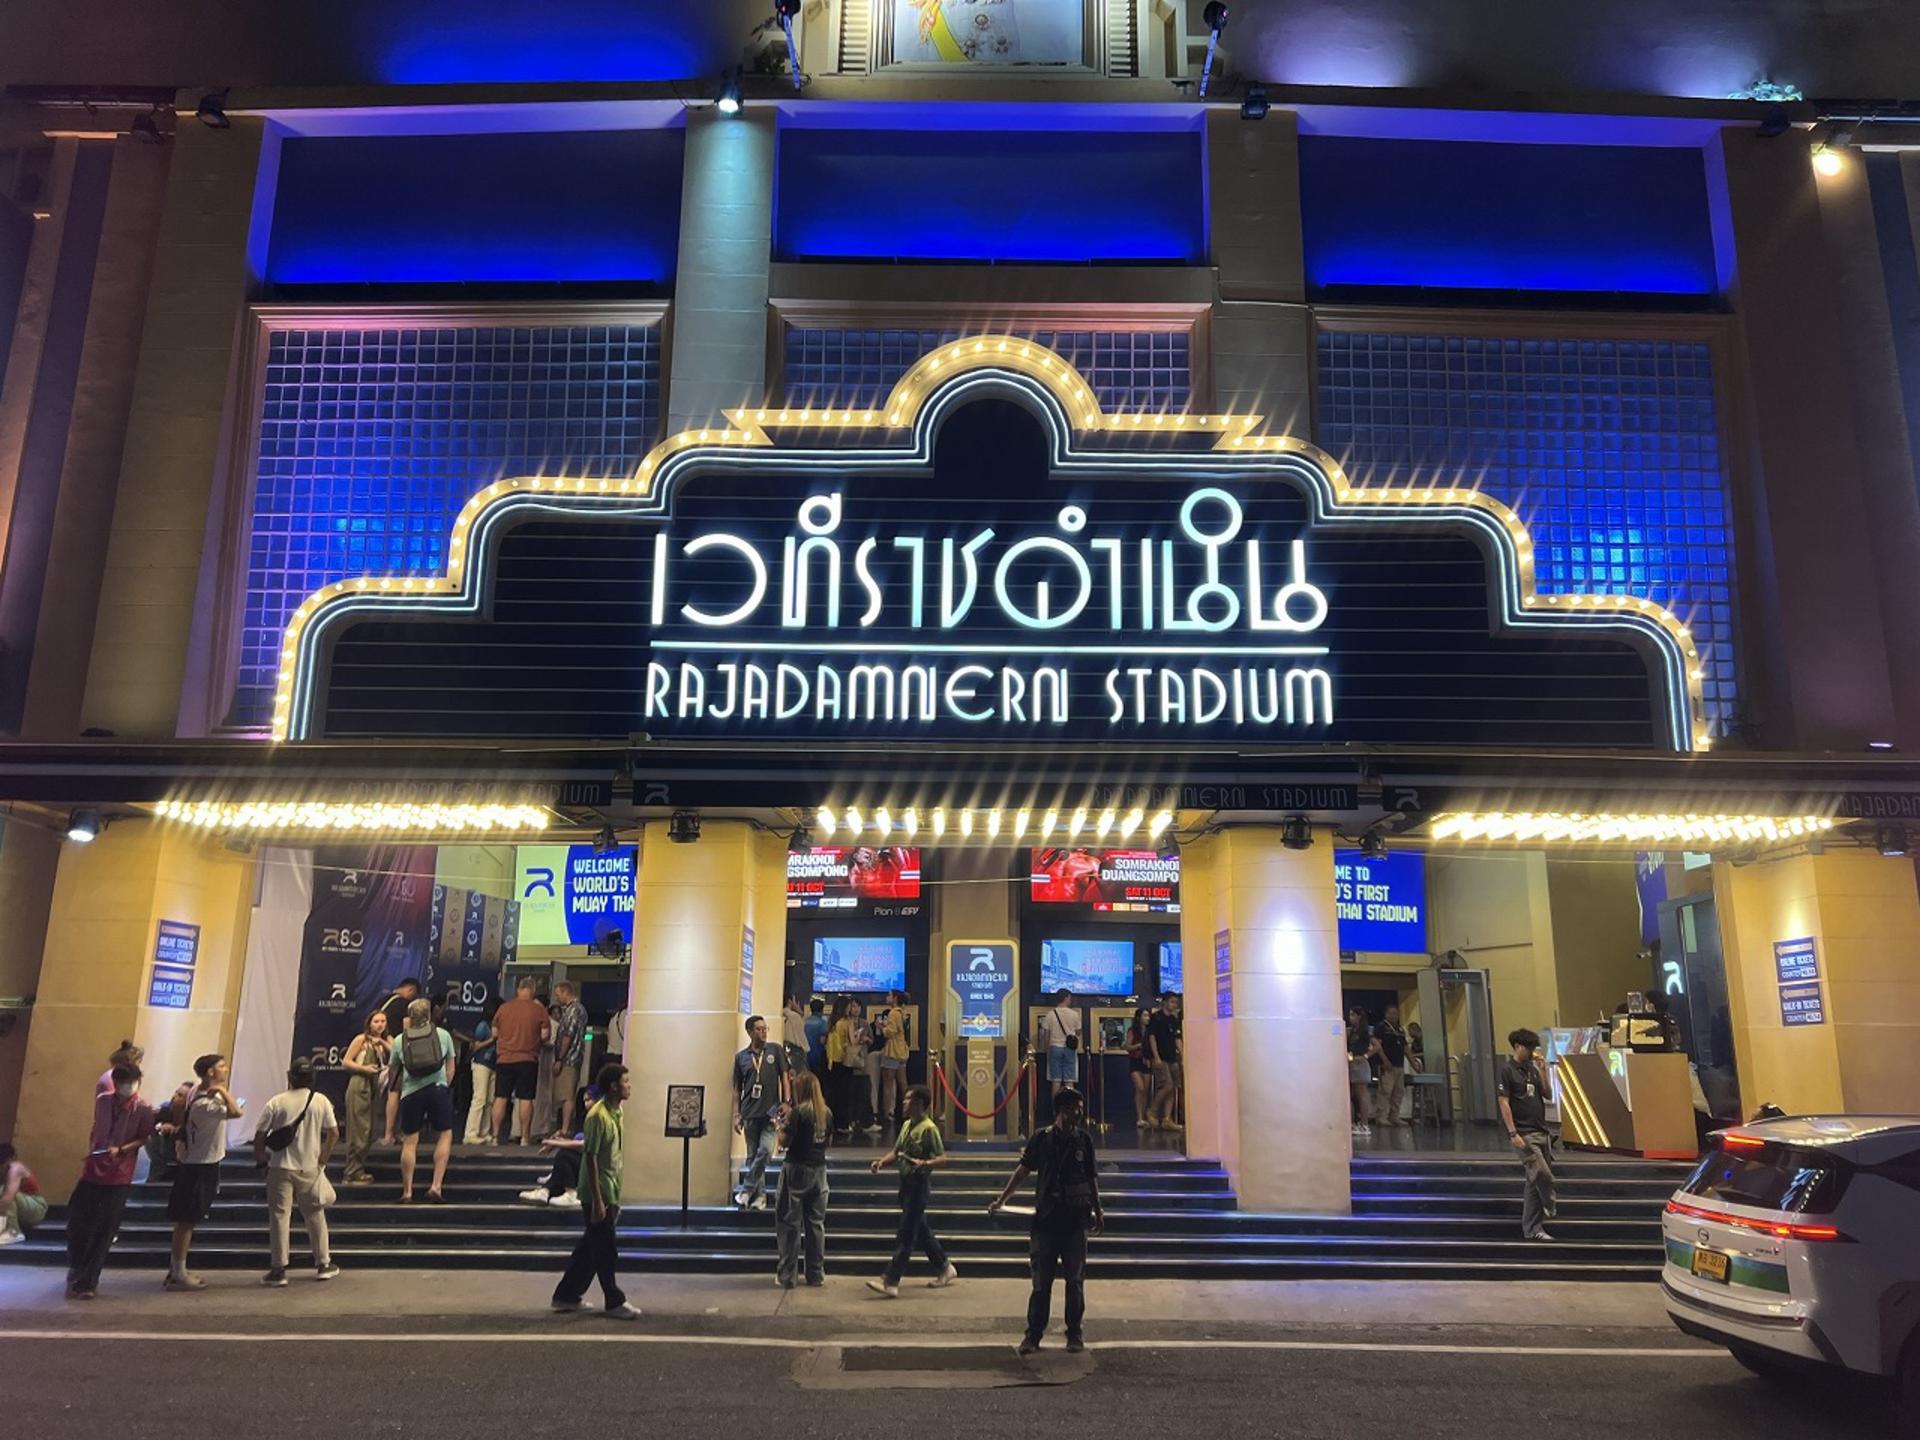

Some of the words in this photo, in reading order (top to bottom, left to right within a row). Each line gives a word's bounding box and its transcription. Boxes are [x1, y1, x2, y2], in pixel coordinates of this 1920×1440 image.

[649, 487, 1330, 633] เวทีราชดำเนิน
[645, 661, 1070, 723] RAJADAMNERN
[1104, 666, 1334, 725] STADIUM
[1263, 787, 1348, 808] STADIUM
[573, 857, 630, 874] WELCOME
[1355, 866, 1370, 881] TO
[573, 875, 629, 893] WORLD'S
[1126, 886, 1141, 897] SAT
[1153, 886, 1170, 897] OCT
[1356, 884, 1390, 902] FIRST
[572, 895, 608, 913] MUAY
[1336, 903, 1362, 920] THAI
[1366, 904, 1418, 923] STADIUM
